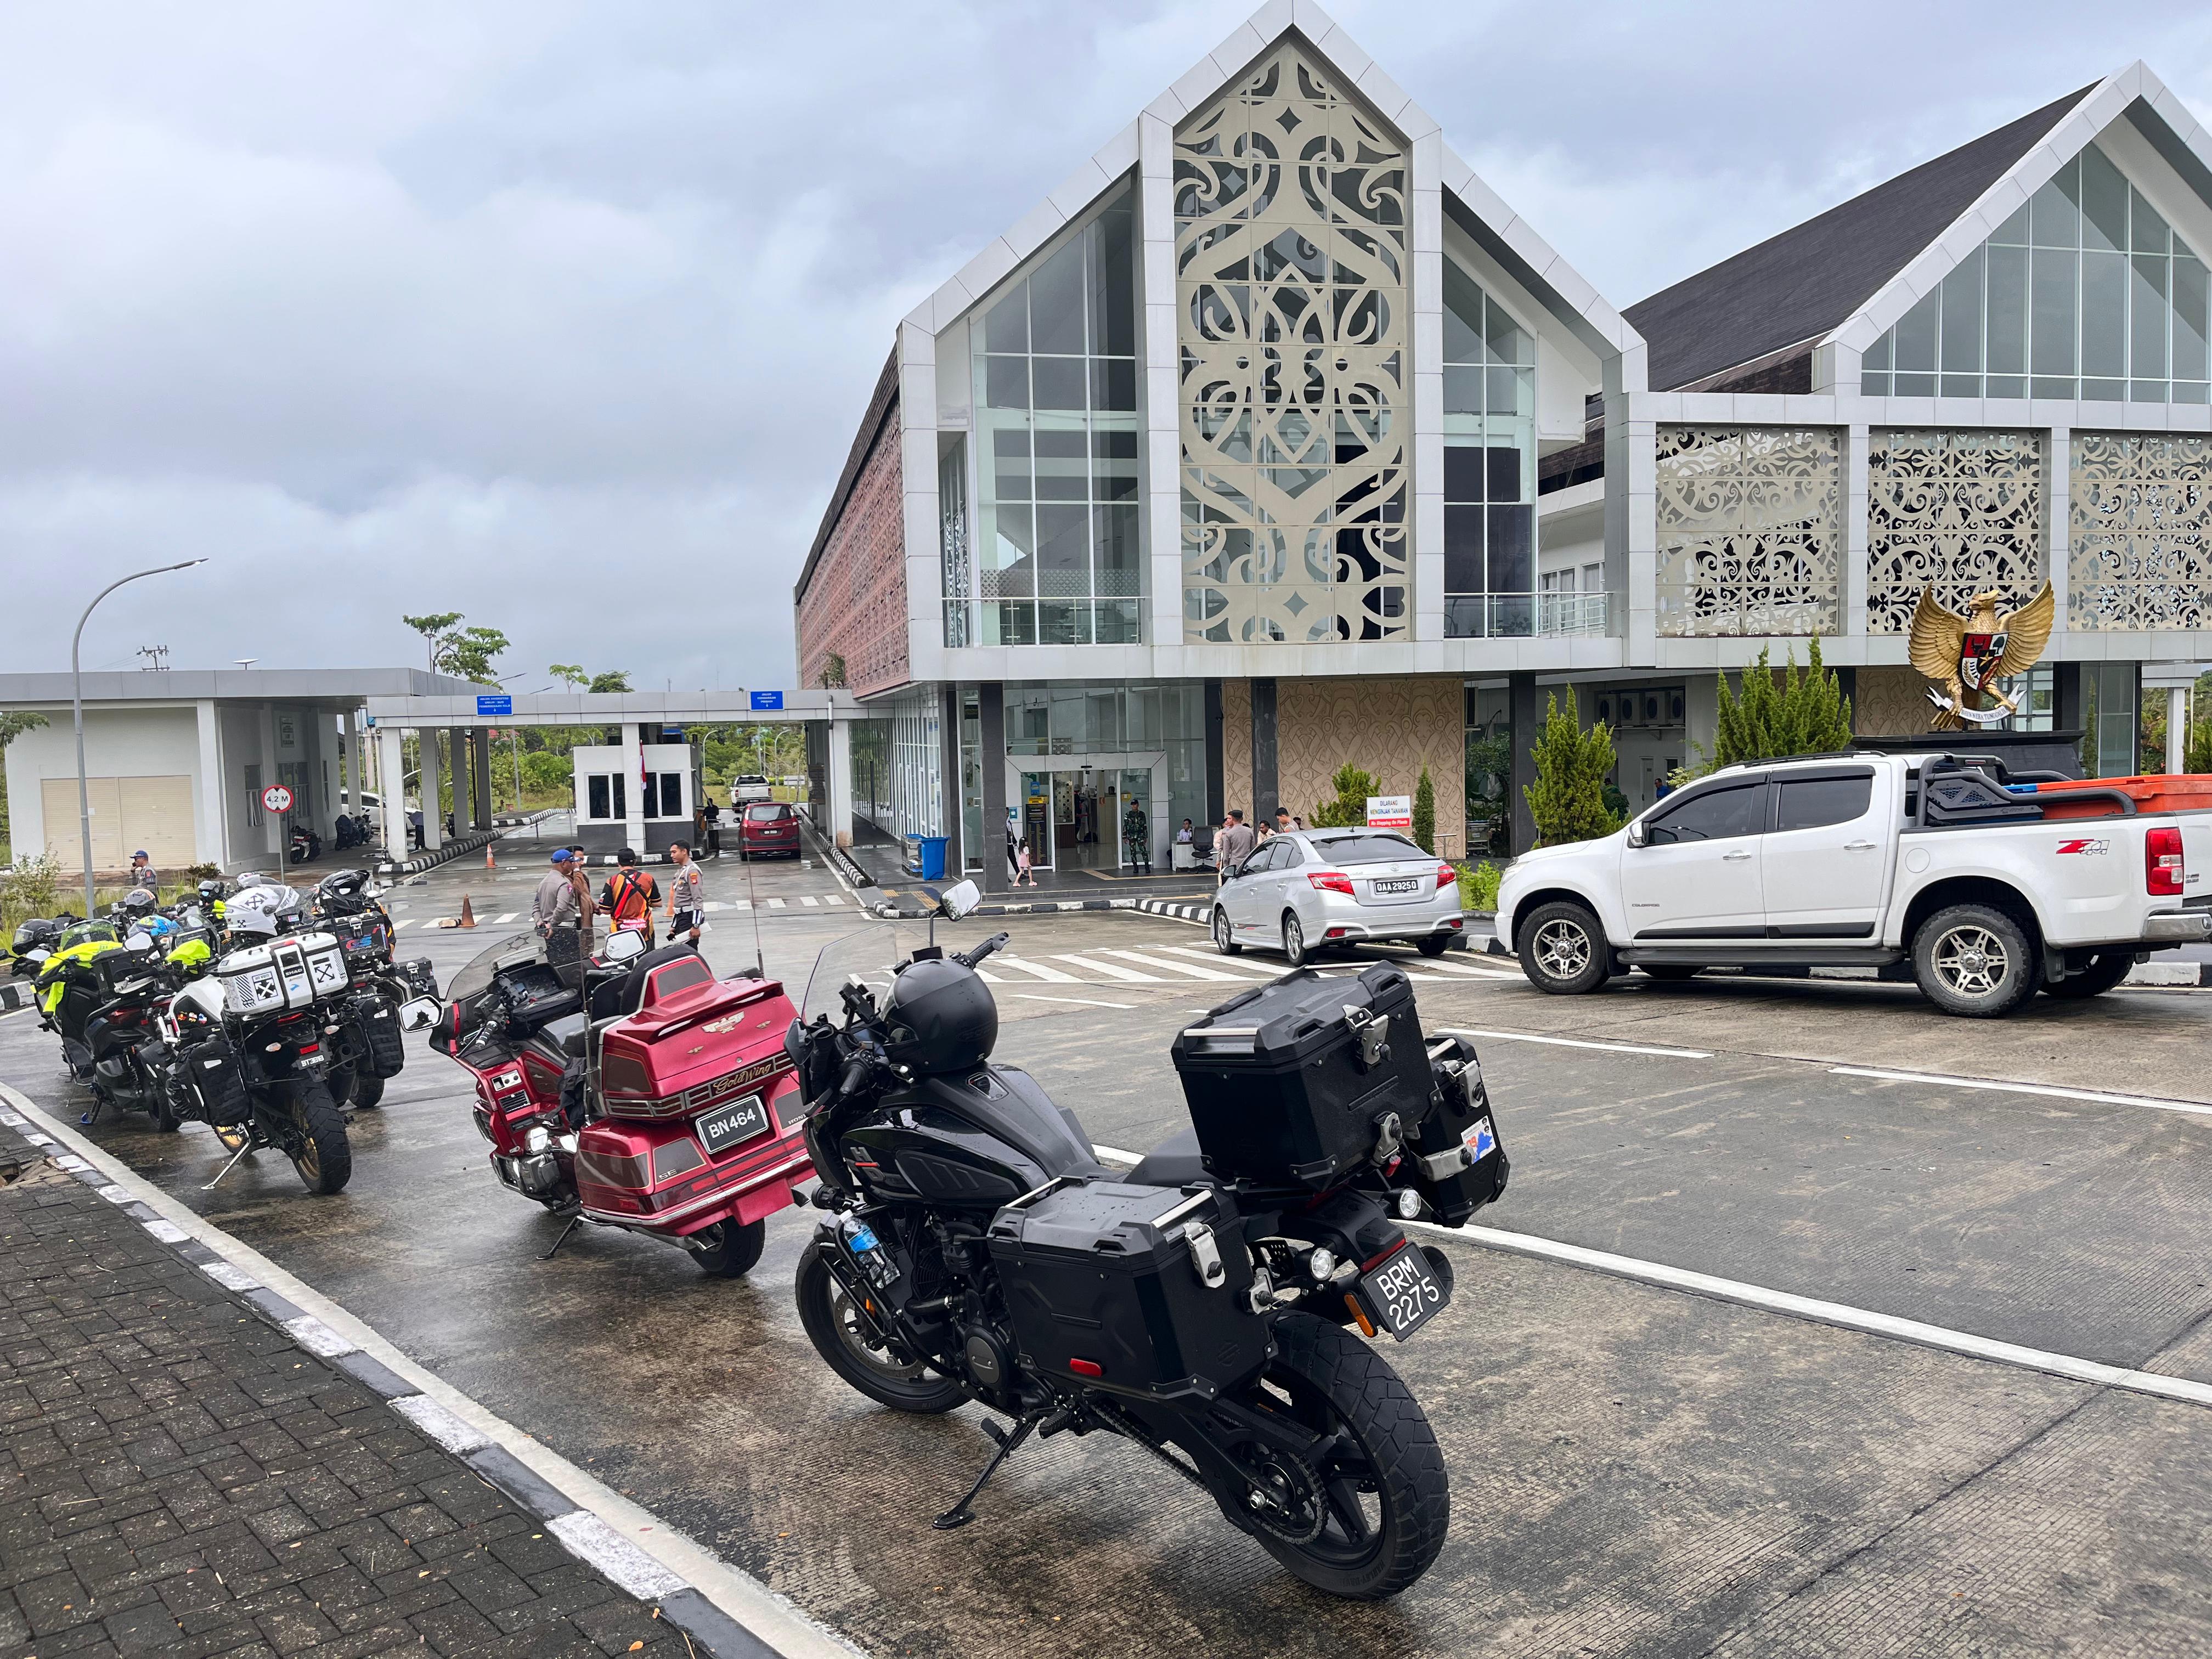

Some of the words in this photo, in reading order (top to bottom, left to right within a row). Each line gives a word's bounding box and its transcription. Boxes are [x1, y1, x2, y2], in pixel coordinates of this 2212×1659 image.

[285, 968, 303, 976] SHAD
[708, 1108, 757, 1138] BN464
[788, 1114, 806, 1125] HON
[658, 1169, 677, 1180] SE
[1376, 1255, 1421, 1301] BRM
[1389, 1276, 1439, 1331] 2275
